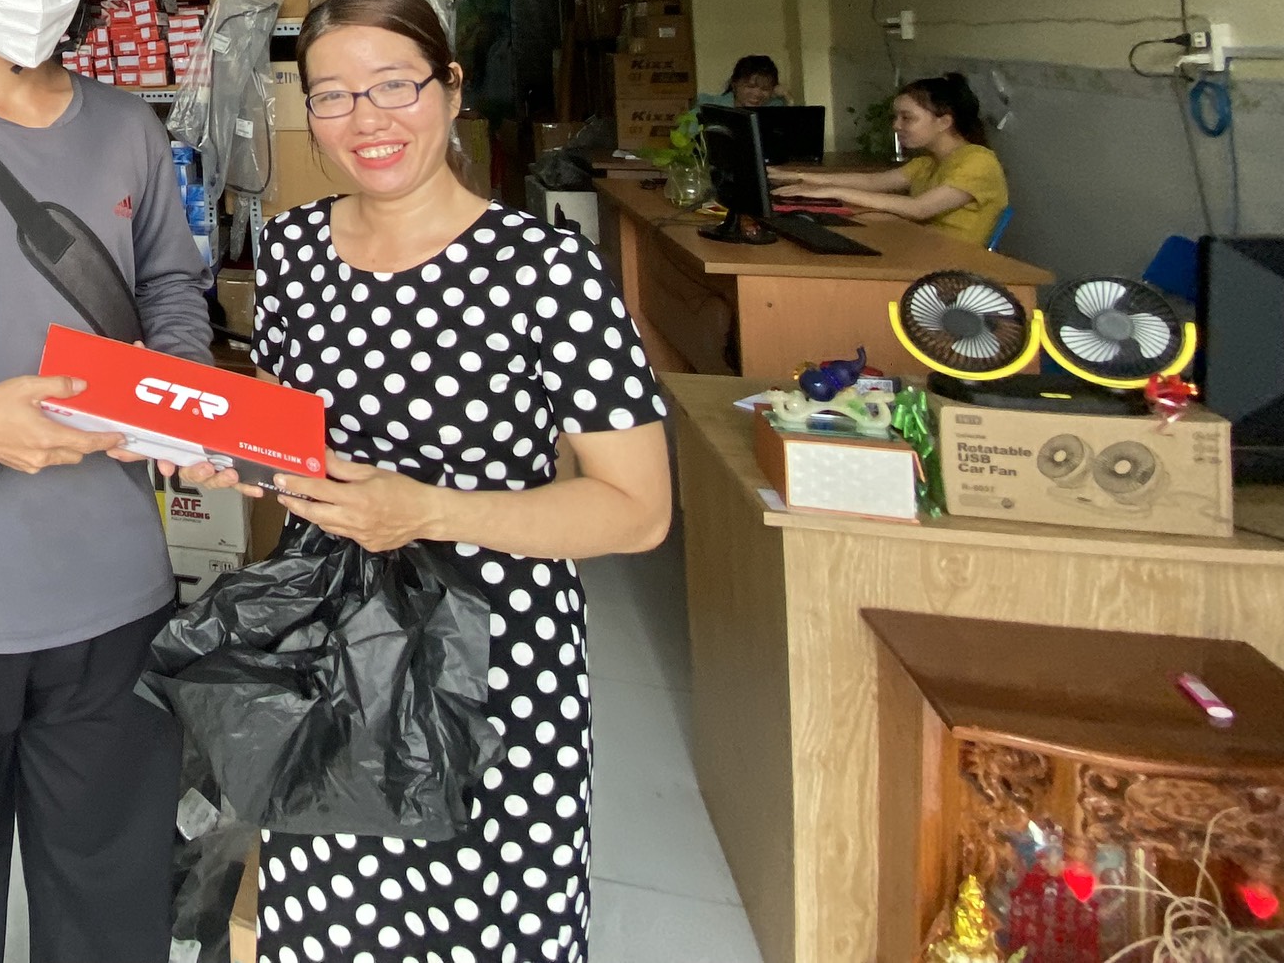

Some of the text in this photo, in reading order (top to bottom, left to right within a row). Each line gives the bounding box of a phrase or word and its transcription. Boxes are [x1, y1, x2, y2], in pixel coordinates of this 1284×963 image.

[134, 376, 230, 420] CTR
[239, 441, 302, 465] STABILIZER LINK
[957, 442, 1032, 458] Rotatable
[957, 453, 991, 464] USB
[958, 463, 1018, 477] Car Fan
[171, 497, 201, 511] ATF
